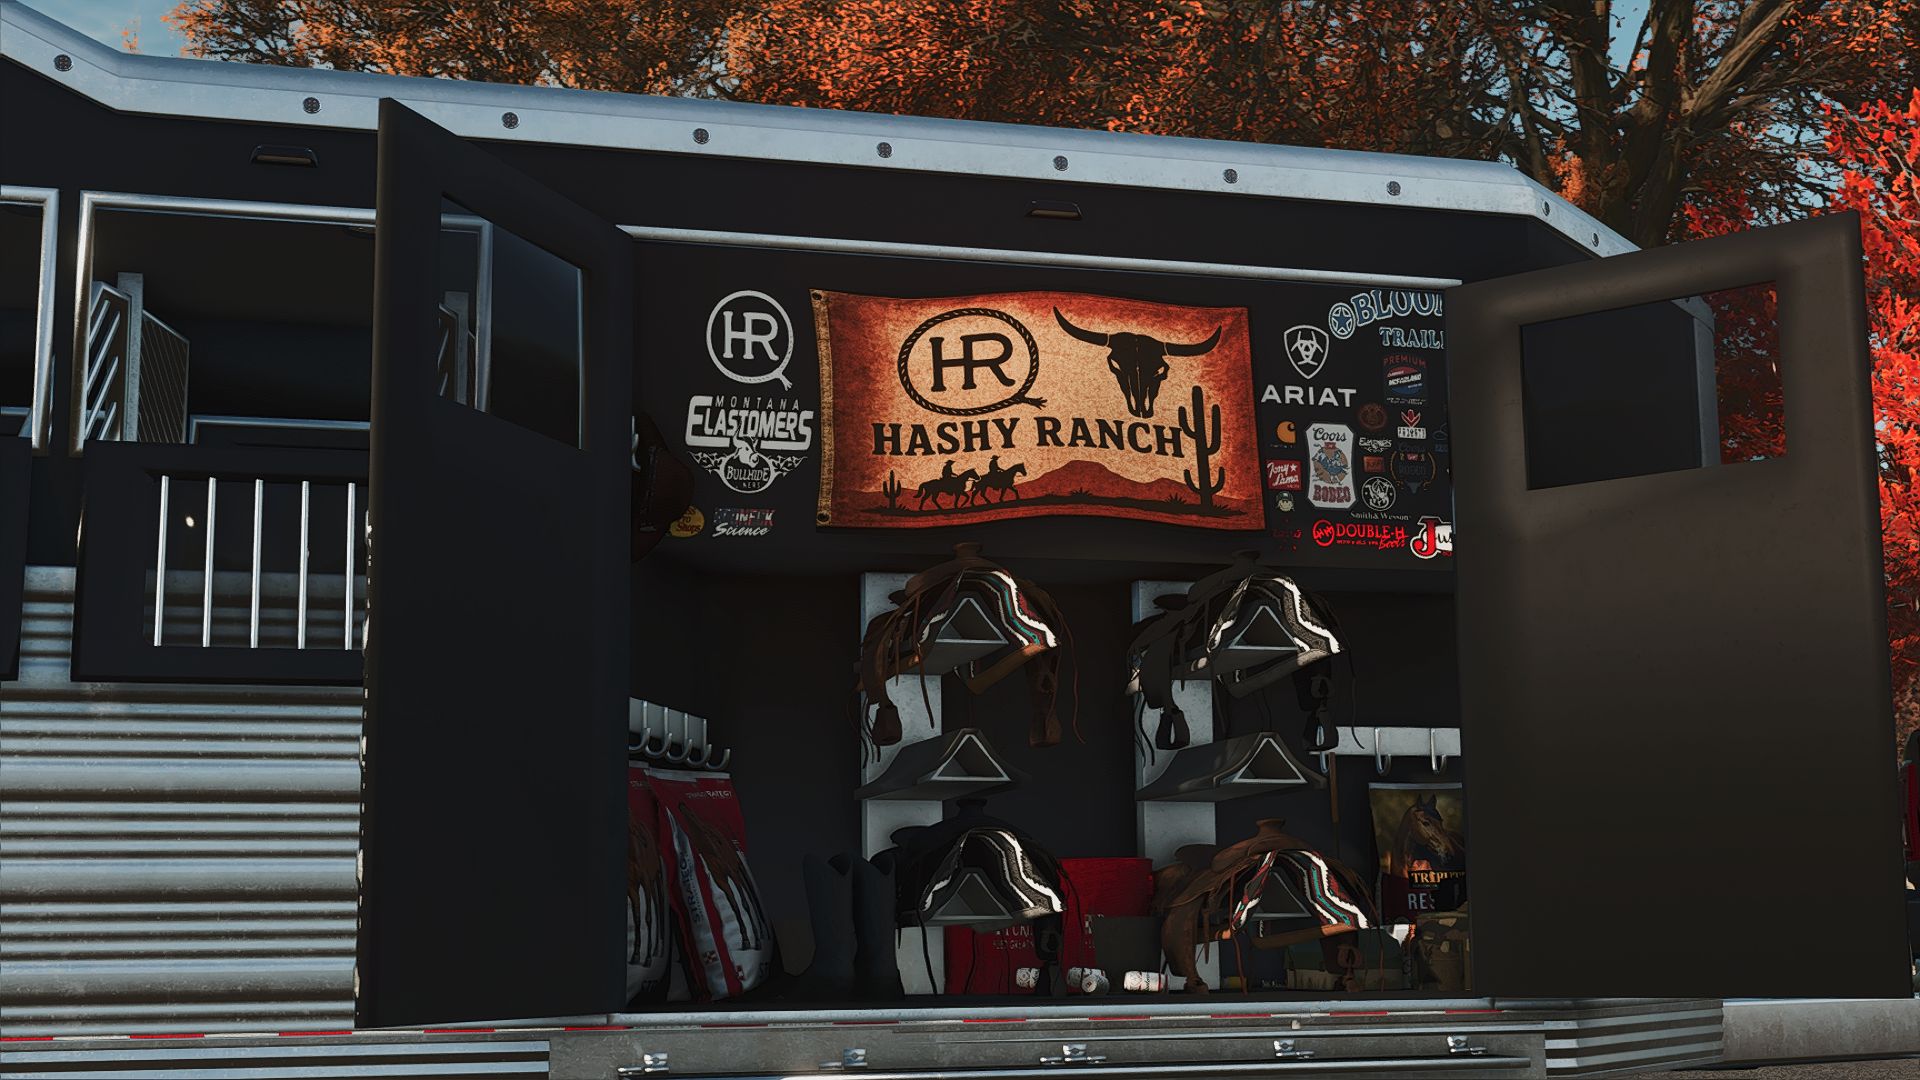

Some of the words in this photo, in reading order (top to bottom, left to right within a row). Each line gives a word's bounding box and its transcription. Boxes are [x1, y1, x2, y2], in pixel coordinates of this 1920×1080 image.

[722, 310, 780, 361] HR
[929, 332, 1017, 393] HR
[1383, 354, 1427, 369] PREMIUM
[715, 395, 800, 411] MONTANA
[1260, 384, 1357, 408] ARIAT
[685, 395, 815, 450] ELASTOMERS
[871, 416, 1021, 457] HASHY
[1036, 415, 1187, 459] RANCH
[1312, 427, 1348, 442] Coors
[726, 464, 770, 482] BULLHIDE
[1266, 461, 1290, 479] Tony
[1272, 474, 1300, 487] Lama
[1312, 484, 1353, 504] RODEO
[711, 521, 770, 538] Science
[1336, 522, 1408, 542] DOUBLE-H
